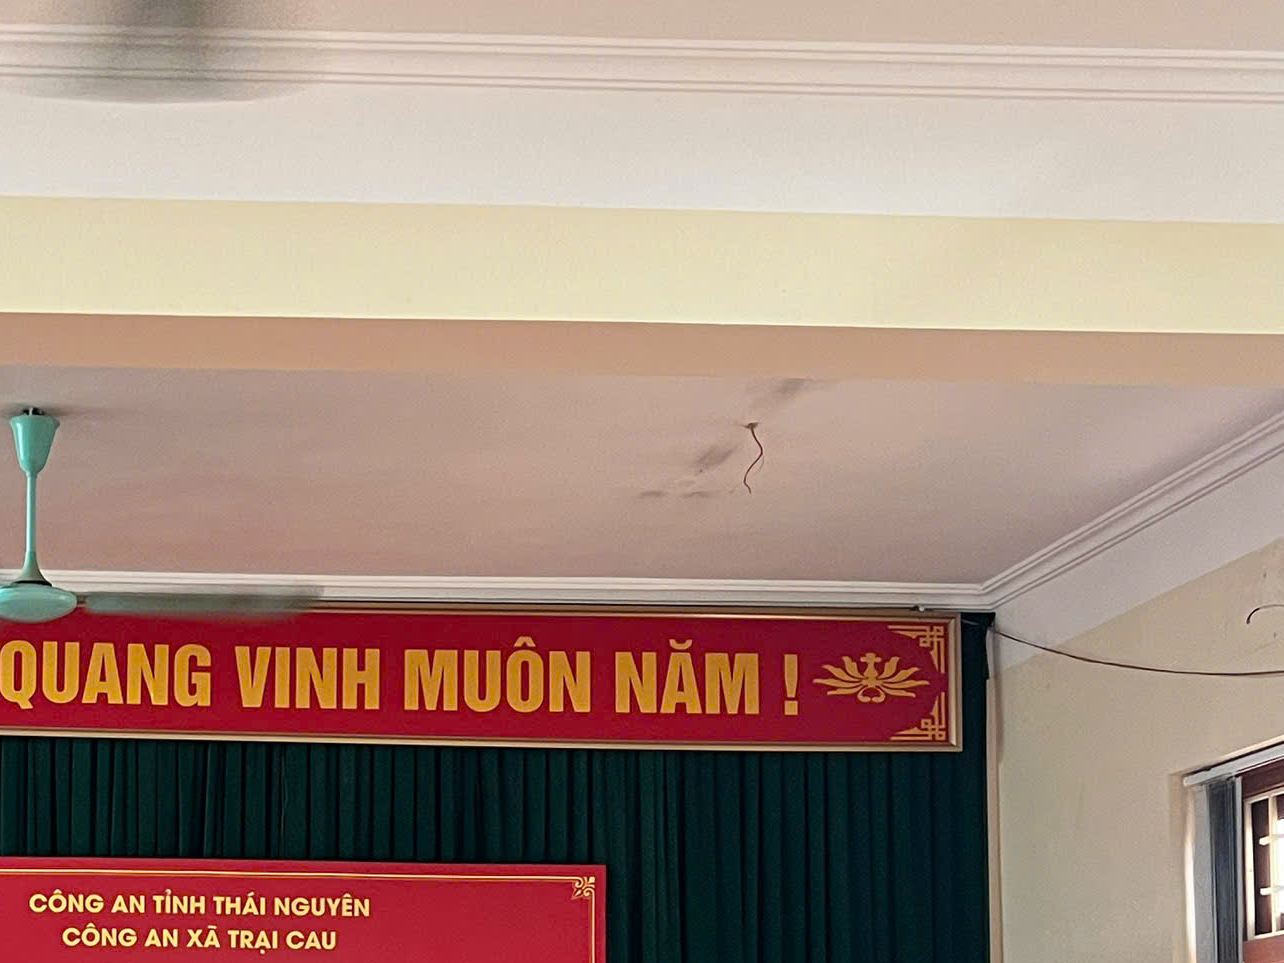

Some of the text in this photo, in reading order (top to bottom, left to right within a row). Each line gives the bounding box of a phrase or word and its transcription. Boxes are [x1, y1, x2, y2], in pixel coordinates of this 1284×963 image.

[0, 640, 212, 710] QUANG
[235, 646, 380, 710] VINH
[404, 636, 591, 713] MUÔN
[615, 639, 759, 715] NĂM
[29, 889, 371, 917] CÔNG AN TỈNH THÁI NGUYÊN
[62, 923, 336, 955] CÔNG AN XÃ TRẠI CAU
